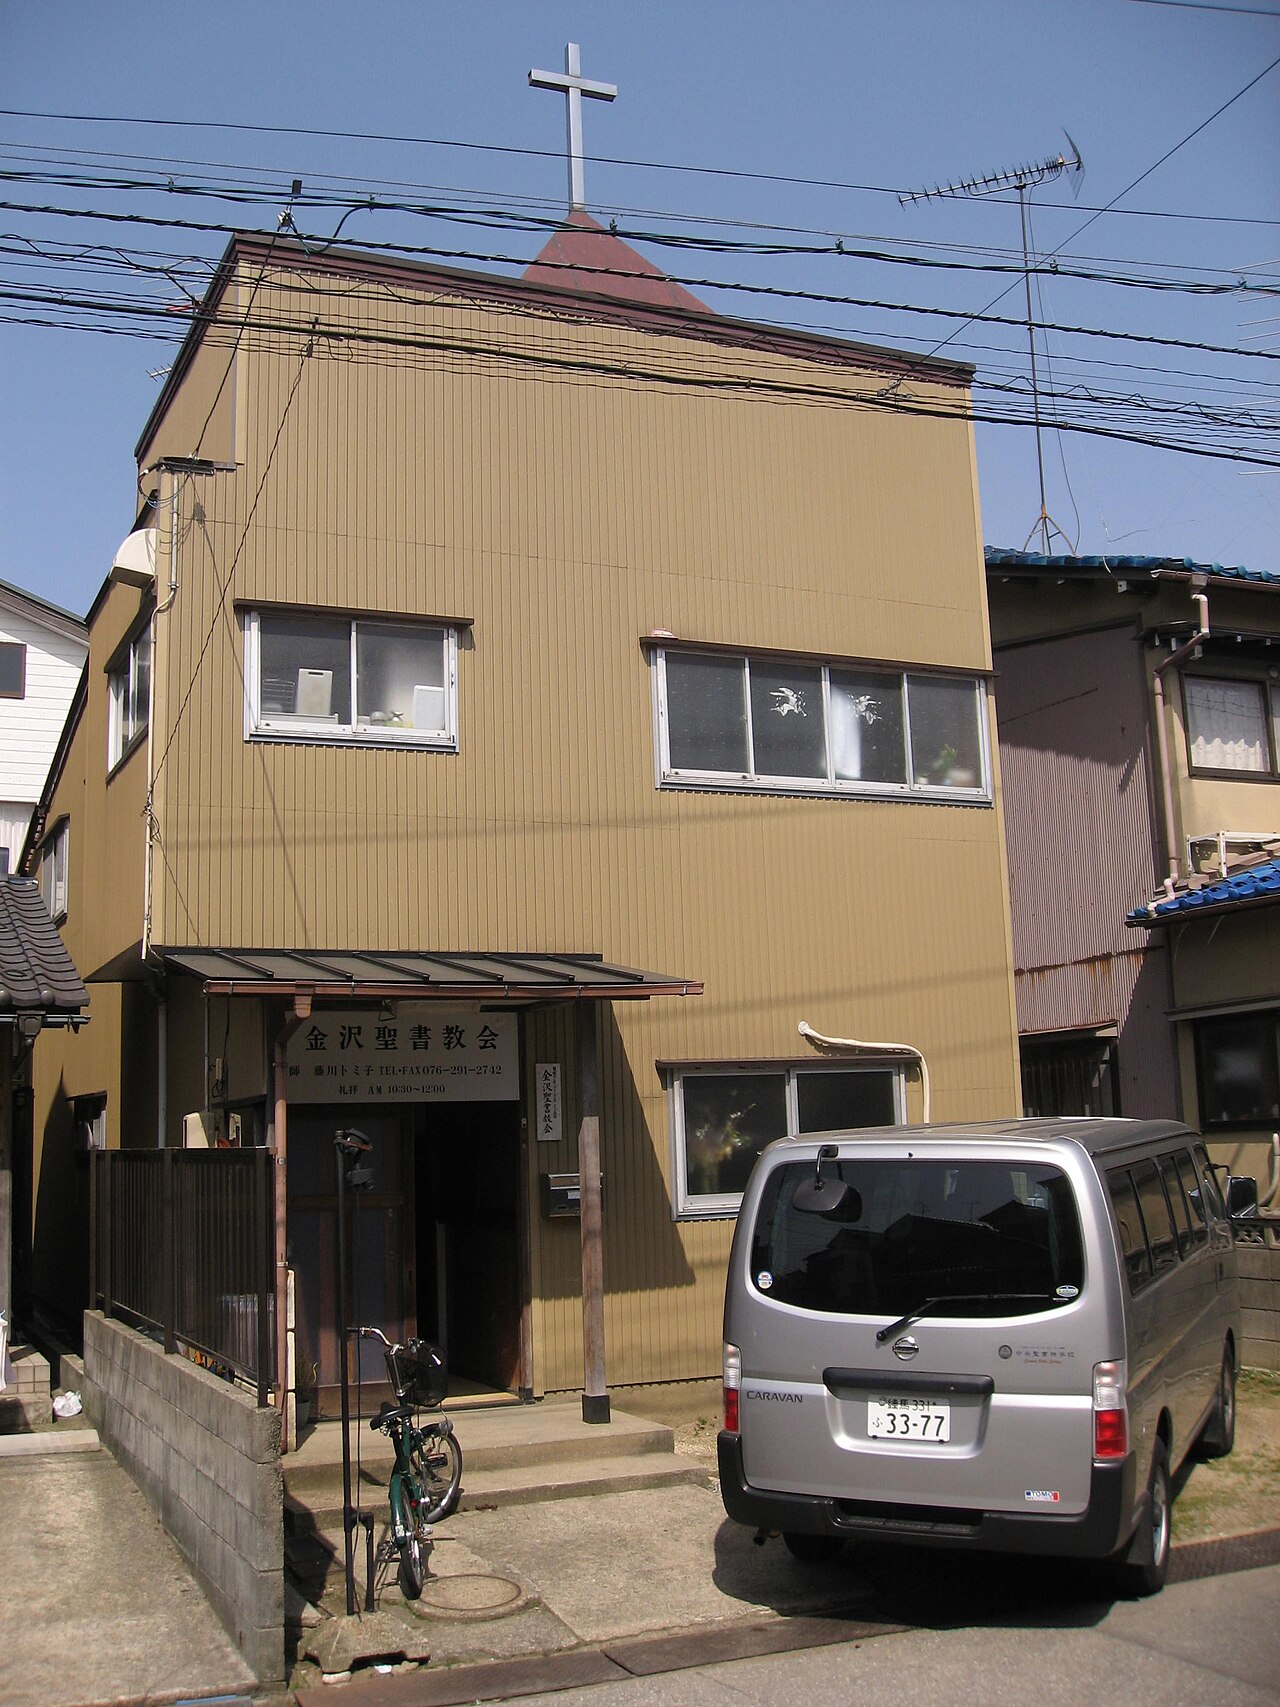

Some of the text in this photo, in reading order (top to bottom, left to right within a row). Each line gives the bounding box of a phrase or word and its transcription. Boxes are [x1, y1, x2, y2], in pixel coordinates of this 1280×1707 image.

[305, 1025, 499, 1050] 金沢聖書教会
[339, 1085, 358, 1095] 礼拝
[367, 1086, 382, 1095] AM
[746, 1390, 803, 1404] CARAVAN
[887, 1398, 930, 1412] 練馬 331
[873, 1412, 945, 1437] ふ 33-77
